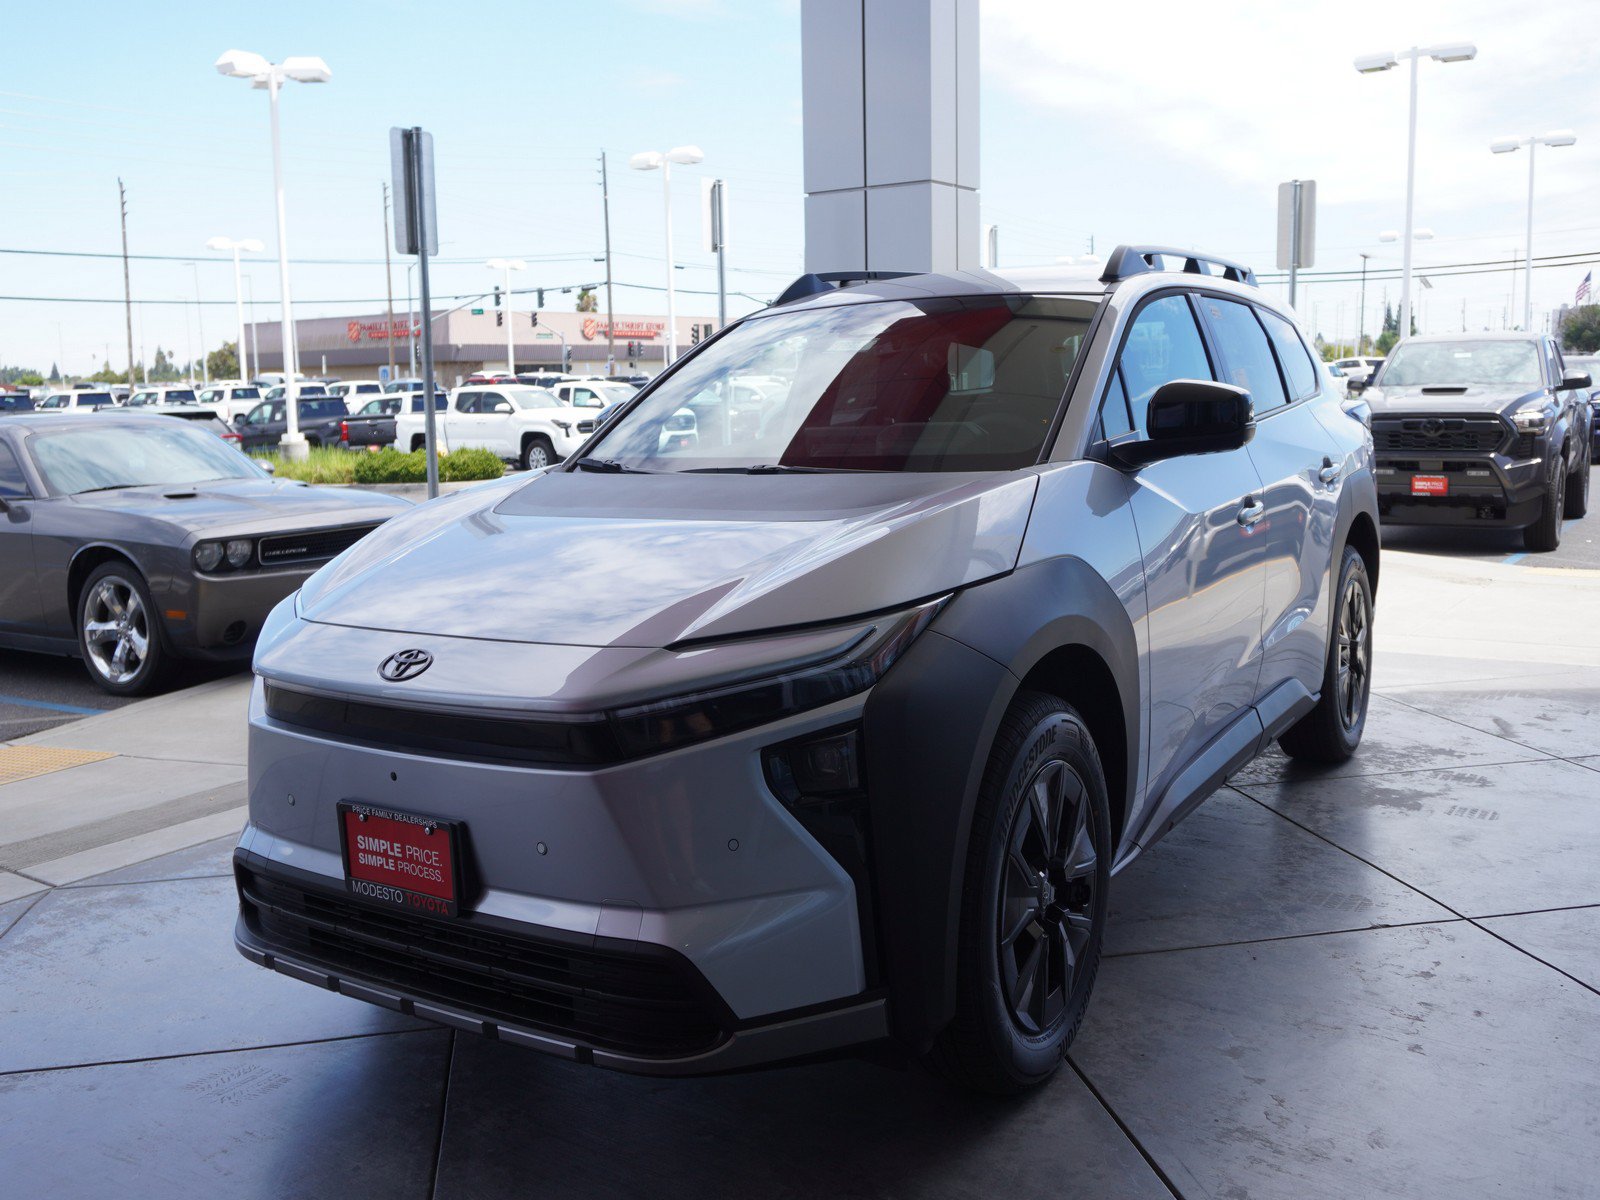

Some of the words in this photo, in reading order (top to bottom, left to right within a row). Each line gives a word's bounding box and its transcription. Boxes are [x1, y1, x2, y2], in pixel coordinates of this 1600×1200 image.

[352, 805, 370, 816] PRICE
[372, 809, 393, 820] FAMILY
[394, 813, 438, 829] DEALERSHIPS
[357, 834, 402, 857] SIMPLE
[405, 845, 443, 867] PRICE.
[358, 852, 395, 871] SIMPLE
[397, 861, 445, 882] PROCESS.
[352, 880, 403, 903] MODESTO
[406, 893, 449, 915] TOYOTA
